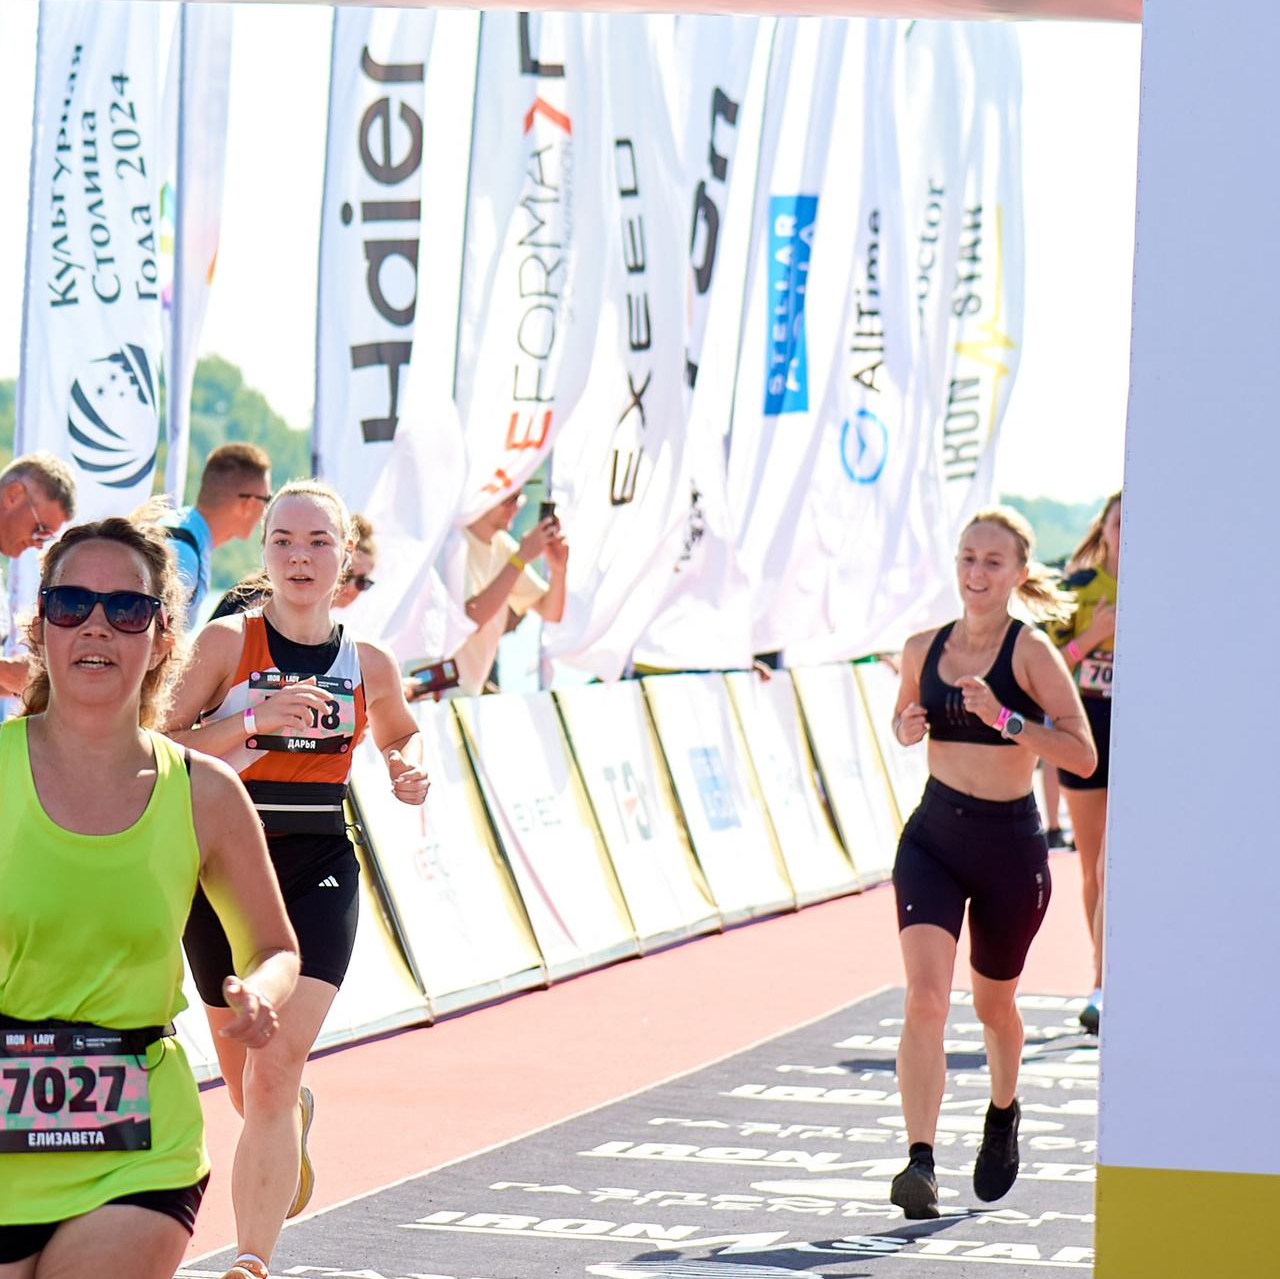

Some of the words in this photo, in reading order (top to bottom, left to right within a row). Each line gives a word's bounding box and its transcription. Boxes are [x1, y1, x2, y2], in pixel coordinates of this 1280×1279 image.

[109, 72, 148, 181] 2024
[81, 108, 122, 305] Столица
[130, 202, 159, 302] Года
[287, 739, 316, 749] ДАРЬЯ
[6, 1033, 25, 1045] IRON
[33, 1033, 55, 1045] LADY
[3, 1065, 126, 1114] 7027
[28, 1130, 105, 1147] ЕЛИЗАВЕТА
[591, 1140, 842, 1164] IRON
[415, 1210, 702, 1241] IRON
